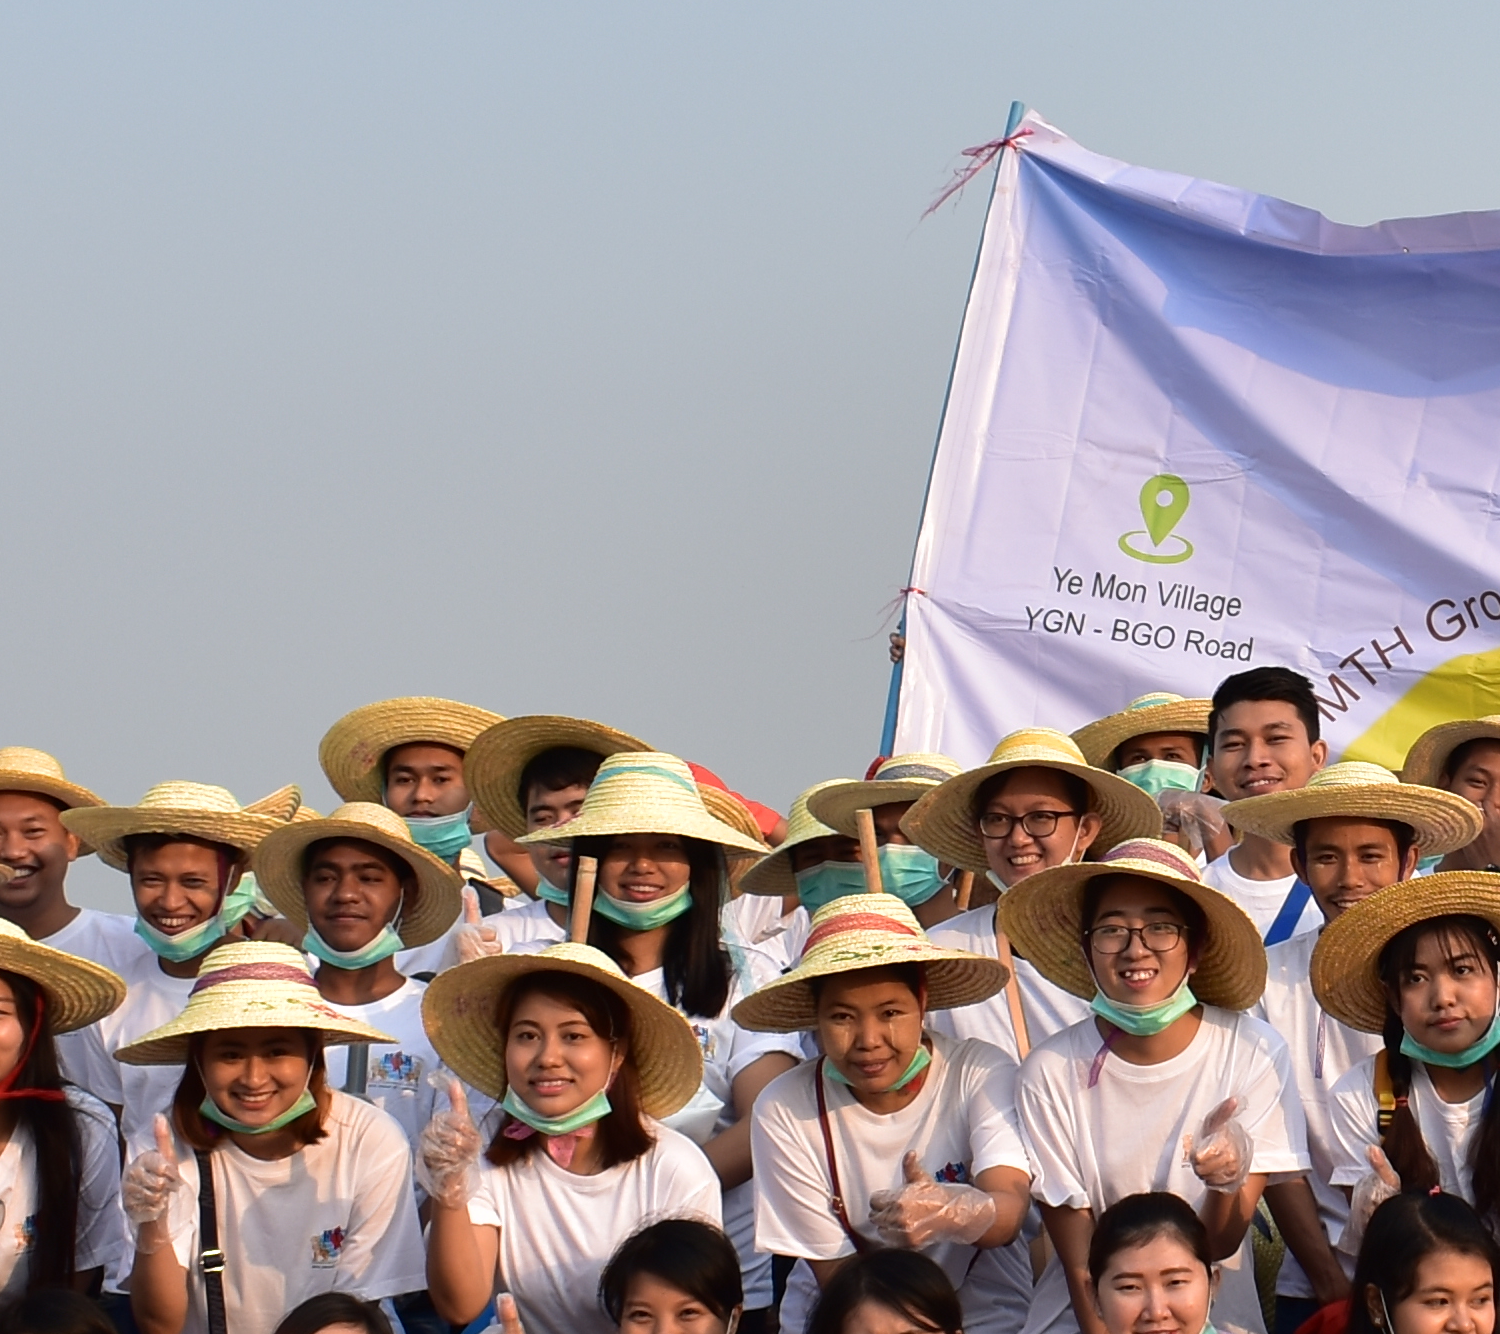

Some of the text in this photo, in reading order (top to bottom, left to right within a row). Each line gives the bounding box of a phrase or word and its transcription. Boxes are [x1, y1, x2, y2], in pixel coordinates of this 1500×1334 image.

[1053, 566, 1242, 621] Ye Mon Village
[1025, 605, 1086, 636] YGN
[1111, 618, 1176, 650] BGO
[1183, 629, 1254, 662] Road
[1314, 625, 1415, 723] MTH
